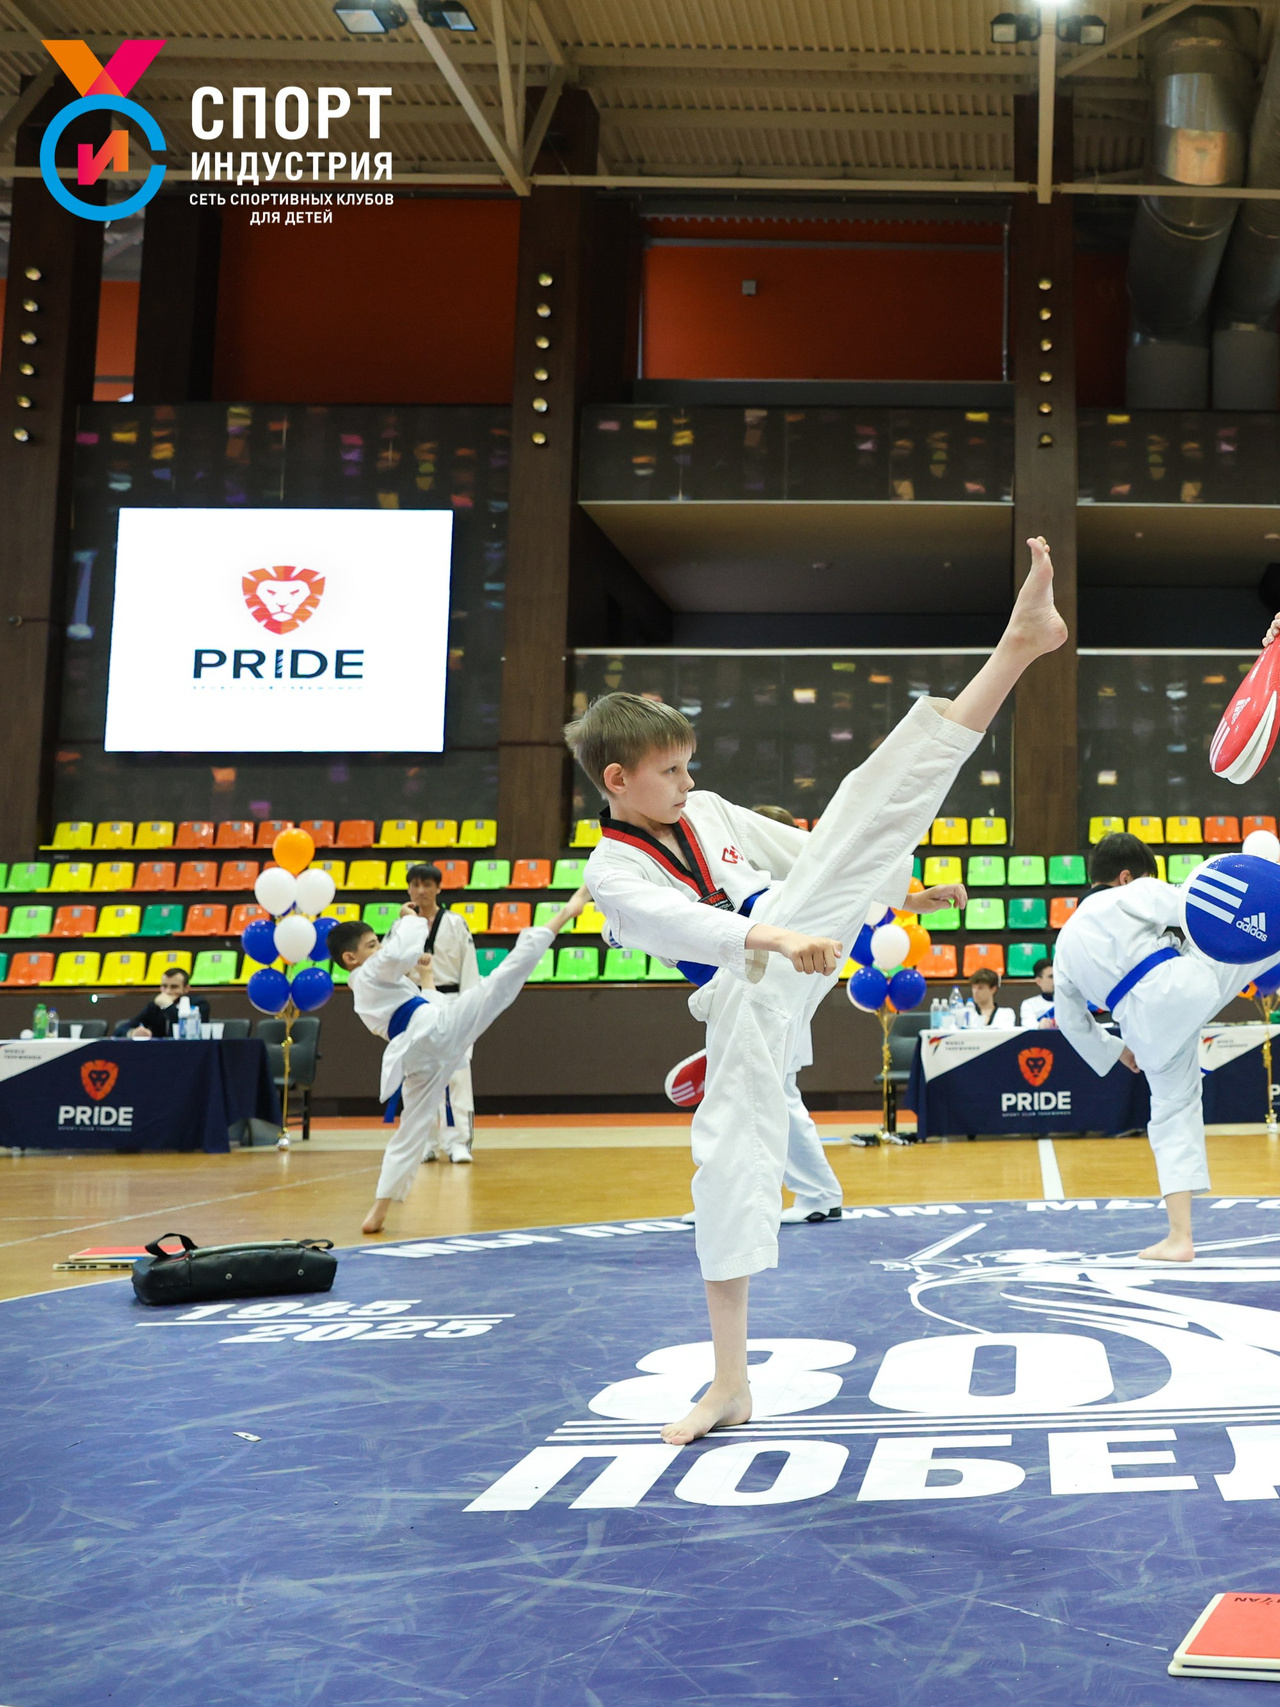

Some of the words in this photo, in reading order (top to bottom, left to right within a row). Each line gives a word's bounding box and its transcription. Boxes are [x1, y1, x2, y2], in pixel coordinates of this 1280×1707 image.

[193, 649, 364, 679] PRIDE
[1235, 920, 1268, 942] adidas
[1001, 1091, 1072, 1112] PRIDE
[58, 1105, 134, 1126] PRIDE
[358, 1233, 564, 1259] МЫ
[175, 1300, 422, 1321] 1945
[218, 1318, 503, 1344] 2025
[588, 1332, 1115, 1421] 80
